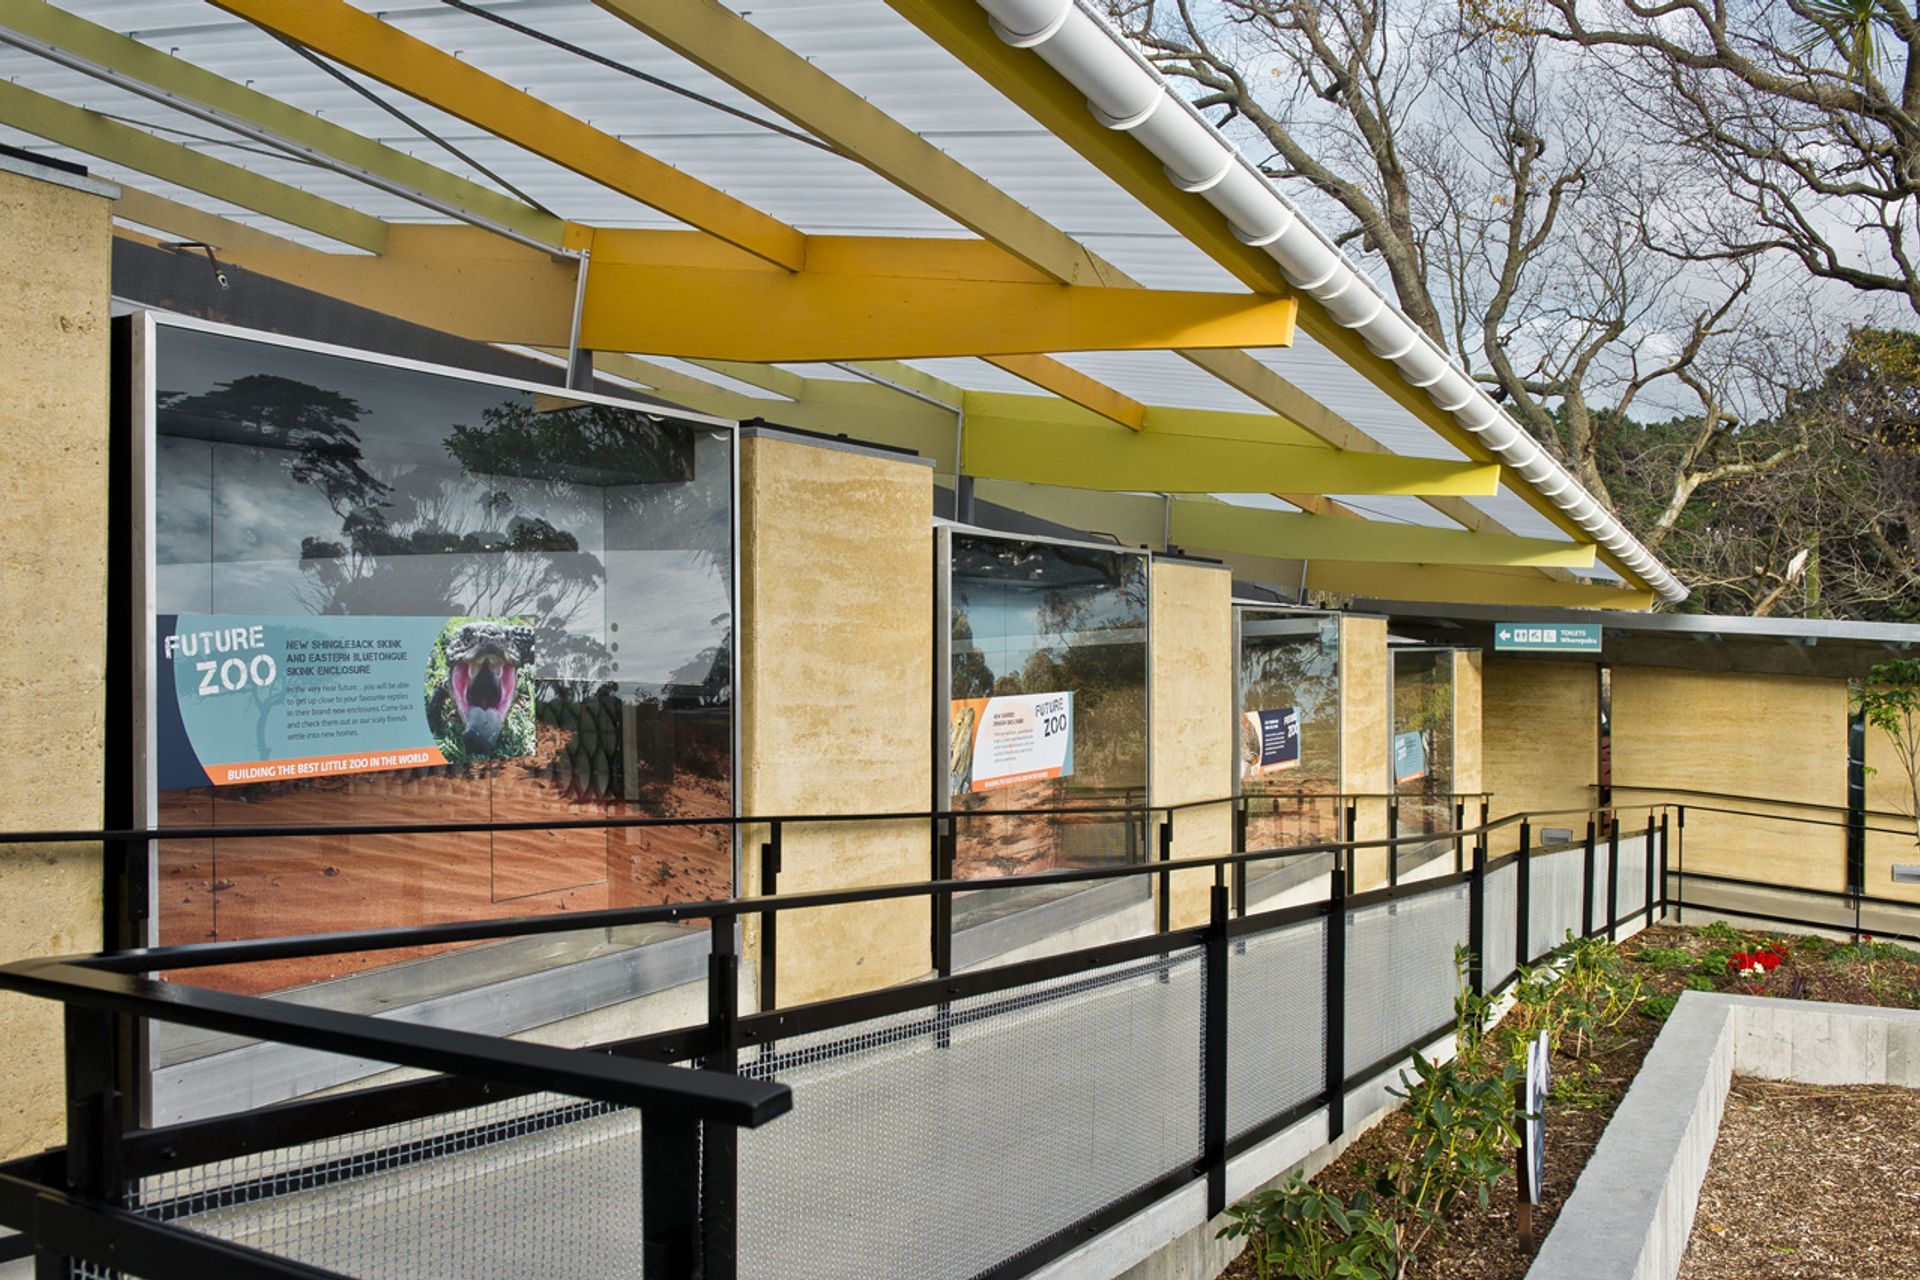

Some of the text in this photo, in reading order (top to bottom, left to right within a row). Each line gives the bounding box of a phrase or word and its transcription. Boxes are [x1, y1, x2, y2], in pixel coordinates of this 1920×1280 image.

[164, 625, 265, 659] FUTURE
[1560, 629, 1587, 637] TOILETS
[286, 639, 402, 650] NEW SHINGLEBACK SKINK
[286, 651, 408, 663] AND EASTERN BLUETONGUE
[196, 654, 276, 696] ZOO
[286, 664, 371, 676] SKINK ENCLOSURE
[1035, 697, 1064, 718] FUTURE
[1043, 713, 1067, 738] ZOO
[227, 753, 429, 781] BUILDING THE BEST LITTLE ZOO IN THE WORLD
